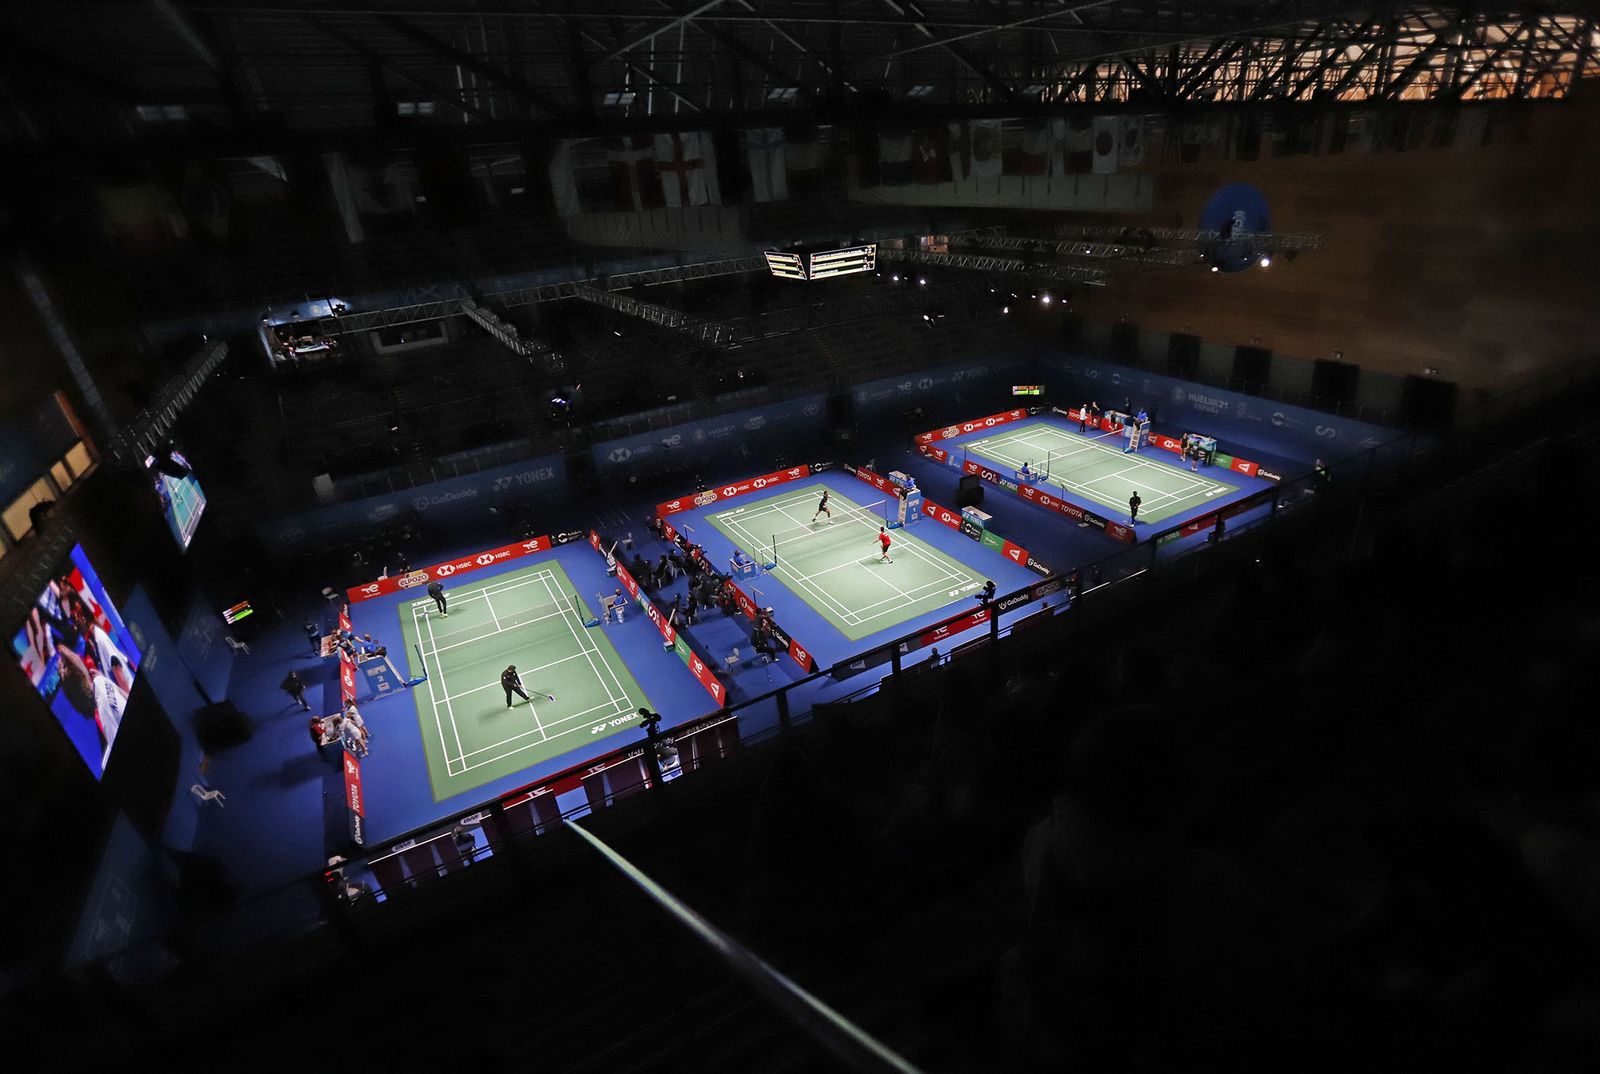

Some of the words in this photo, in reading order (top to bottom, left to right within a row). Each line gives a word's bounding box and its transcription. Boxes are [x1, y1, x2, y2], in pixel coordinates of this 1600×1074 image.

[515, 467, 555, 486] YONEX
[431, 488, 478, 505] GoDaddy
[1060, 504, 1083, 519] TOYOTA
[1007, 594, 1029, 606] GoDaddy
[608, 712, 640, 728] YONEX
[351, 783, 360, 813] TOYOTA
